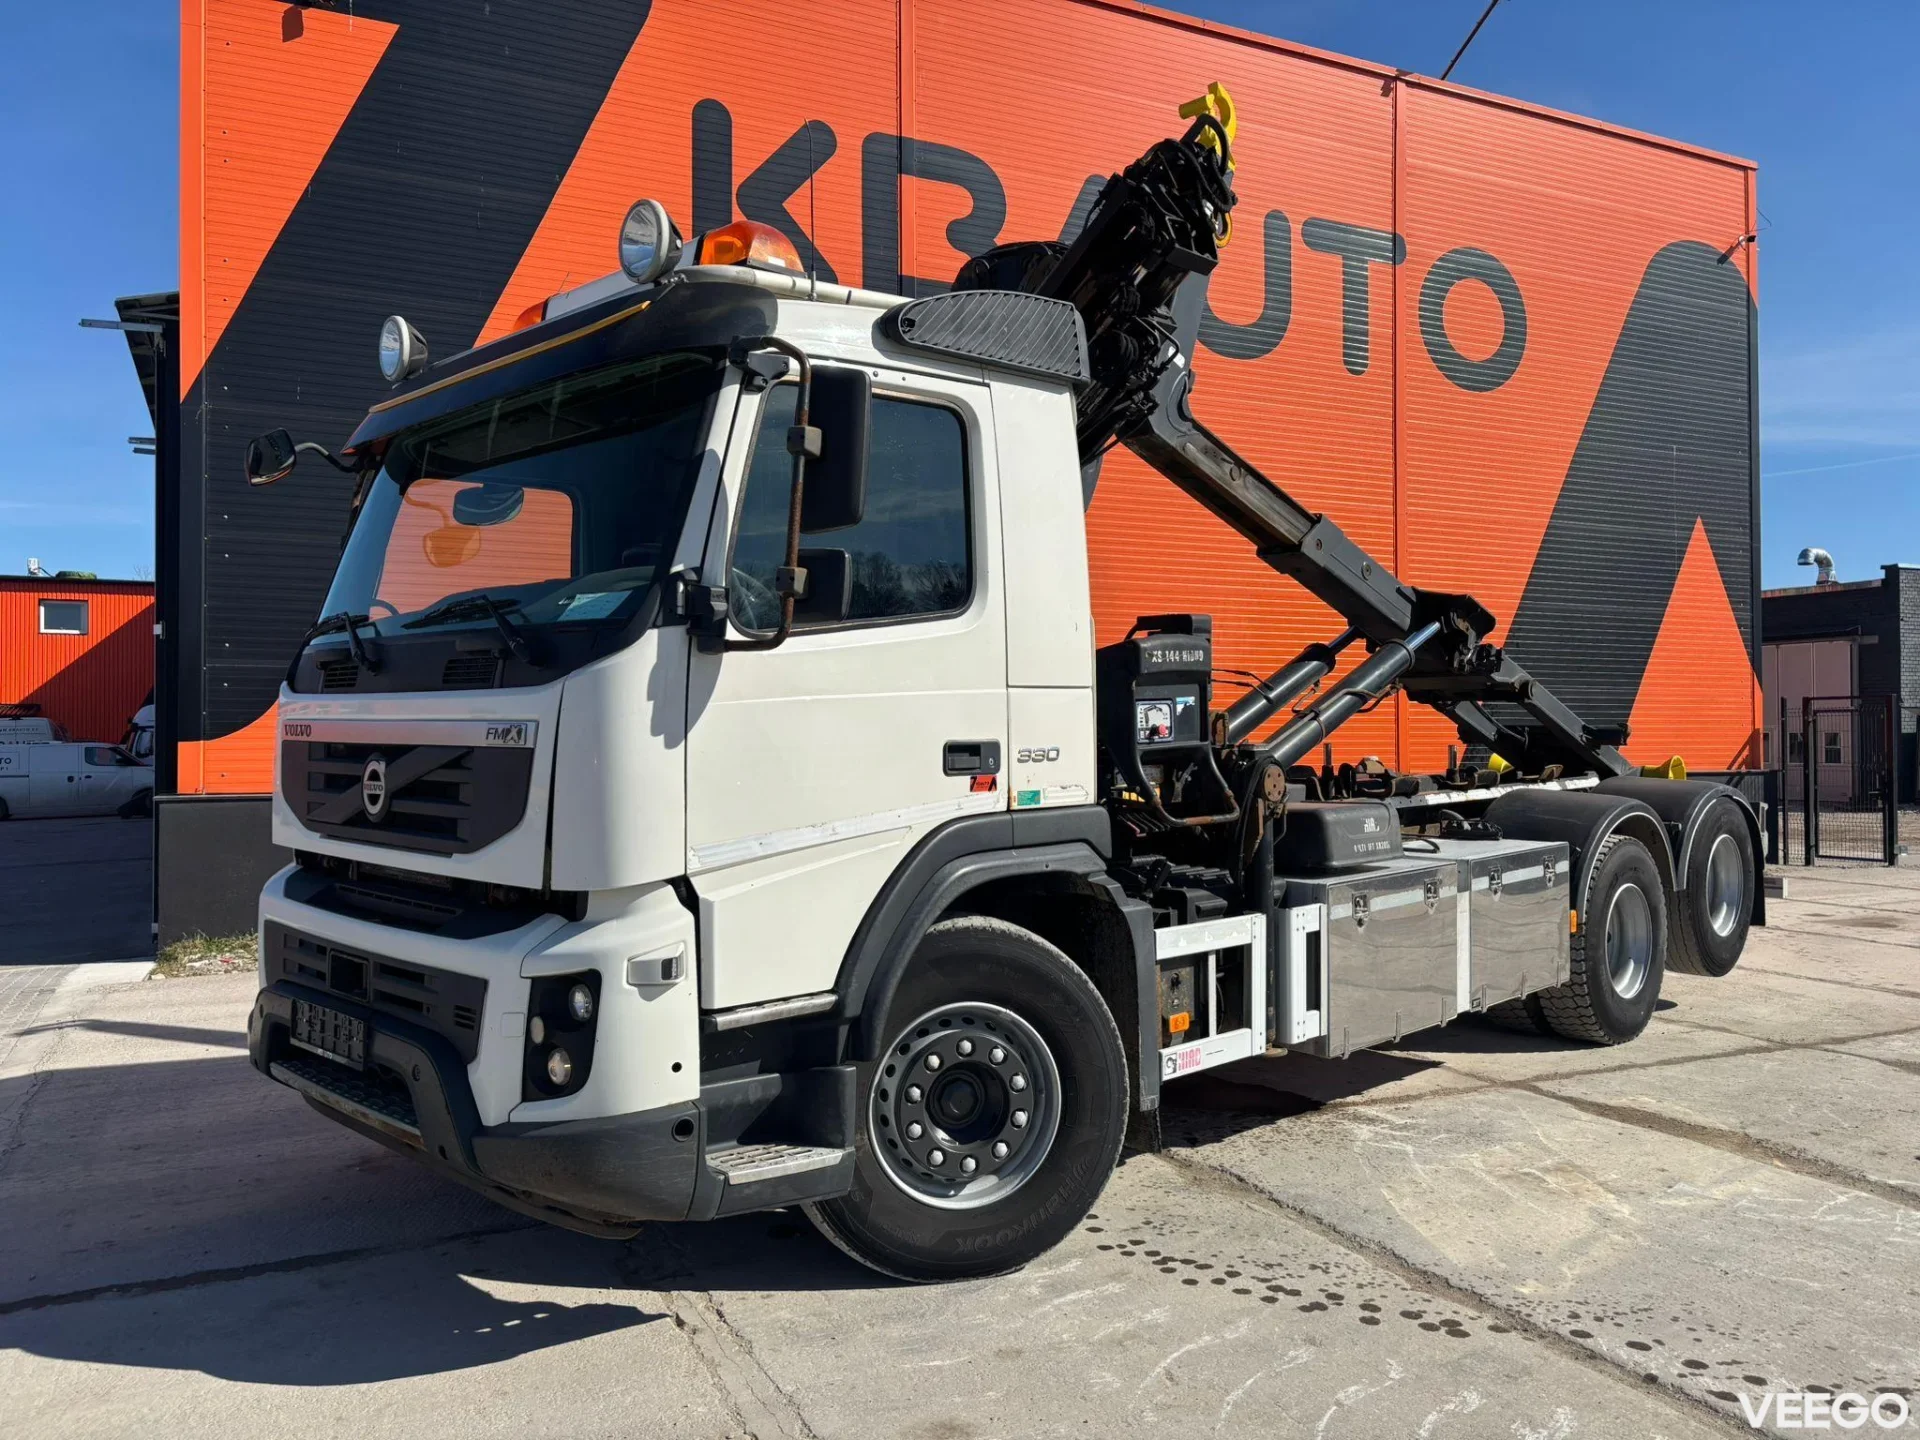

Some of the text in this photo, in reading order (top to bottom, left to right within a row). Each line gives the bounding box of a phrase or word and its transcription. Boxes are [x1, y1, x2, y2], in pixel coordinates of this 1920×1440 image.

[692, 98, 1527, 392] KBUTO
[1152, 650, 1162, 662] XS
[1165, 650, 1179, 661] 144
[284, 724, 311, 737] VOLVO
[486, 724, 523, 743] FMX
[1017, 747, 1060, 763] 330
